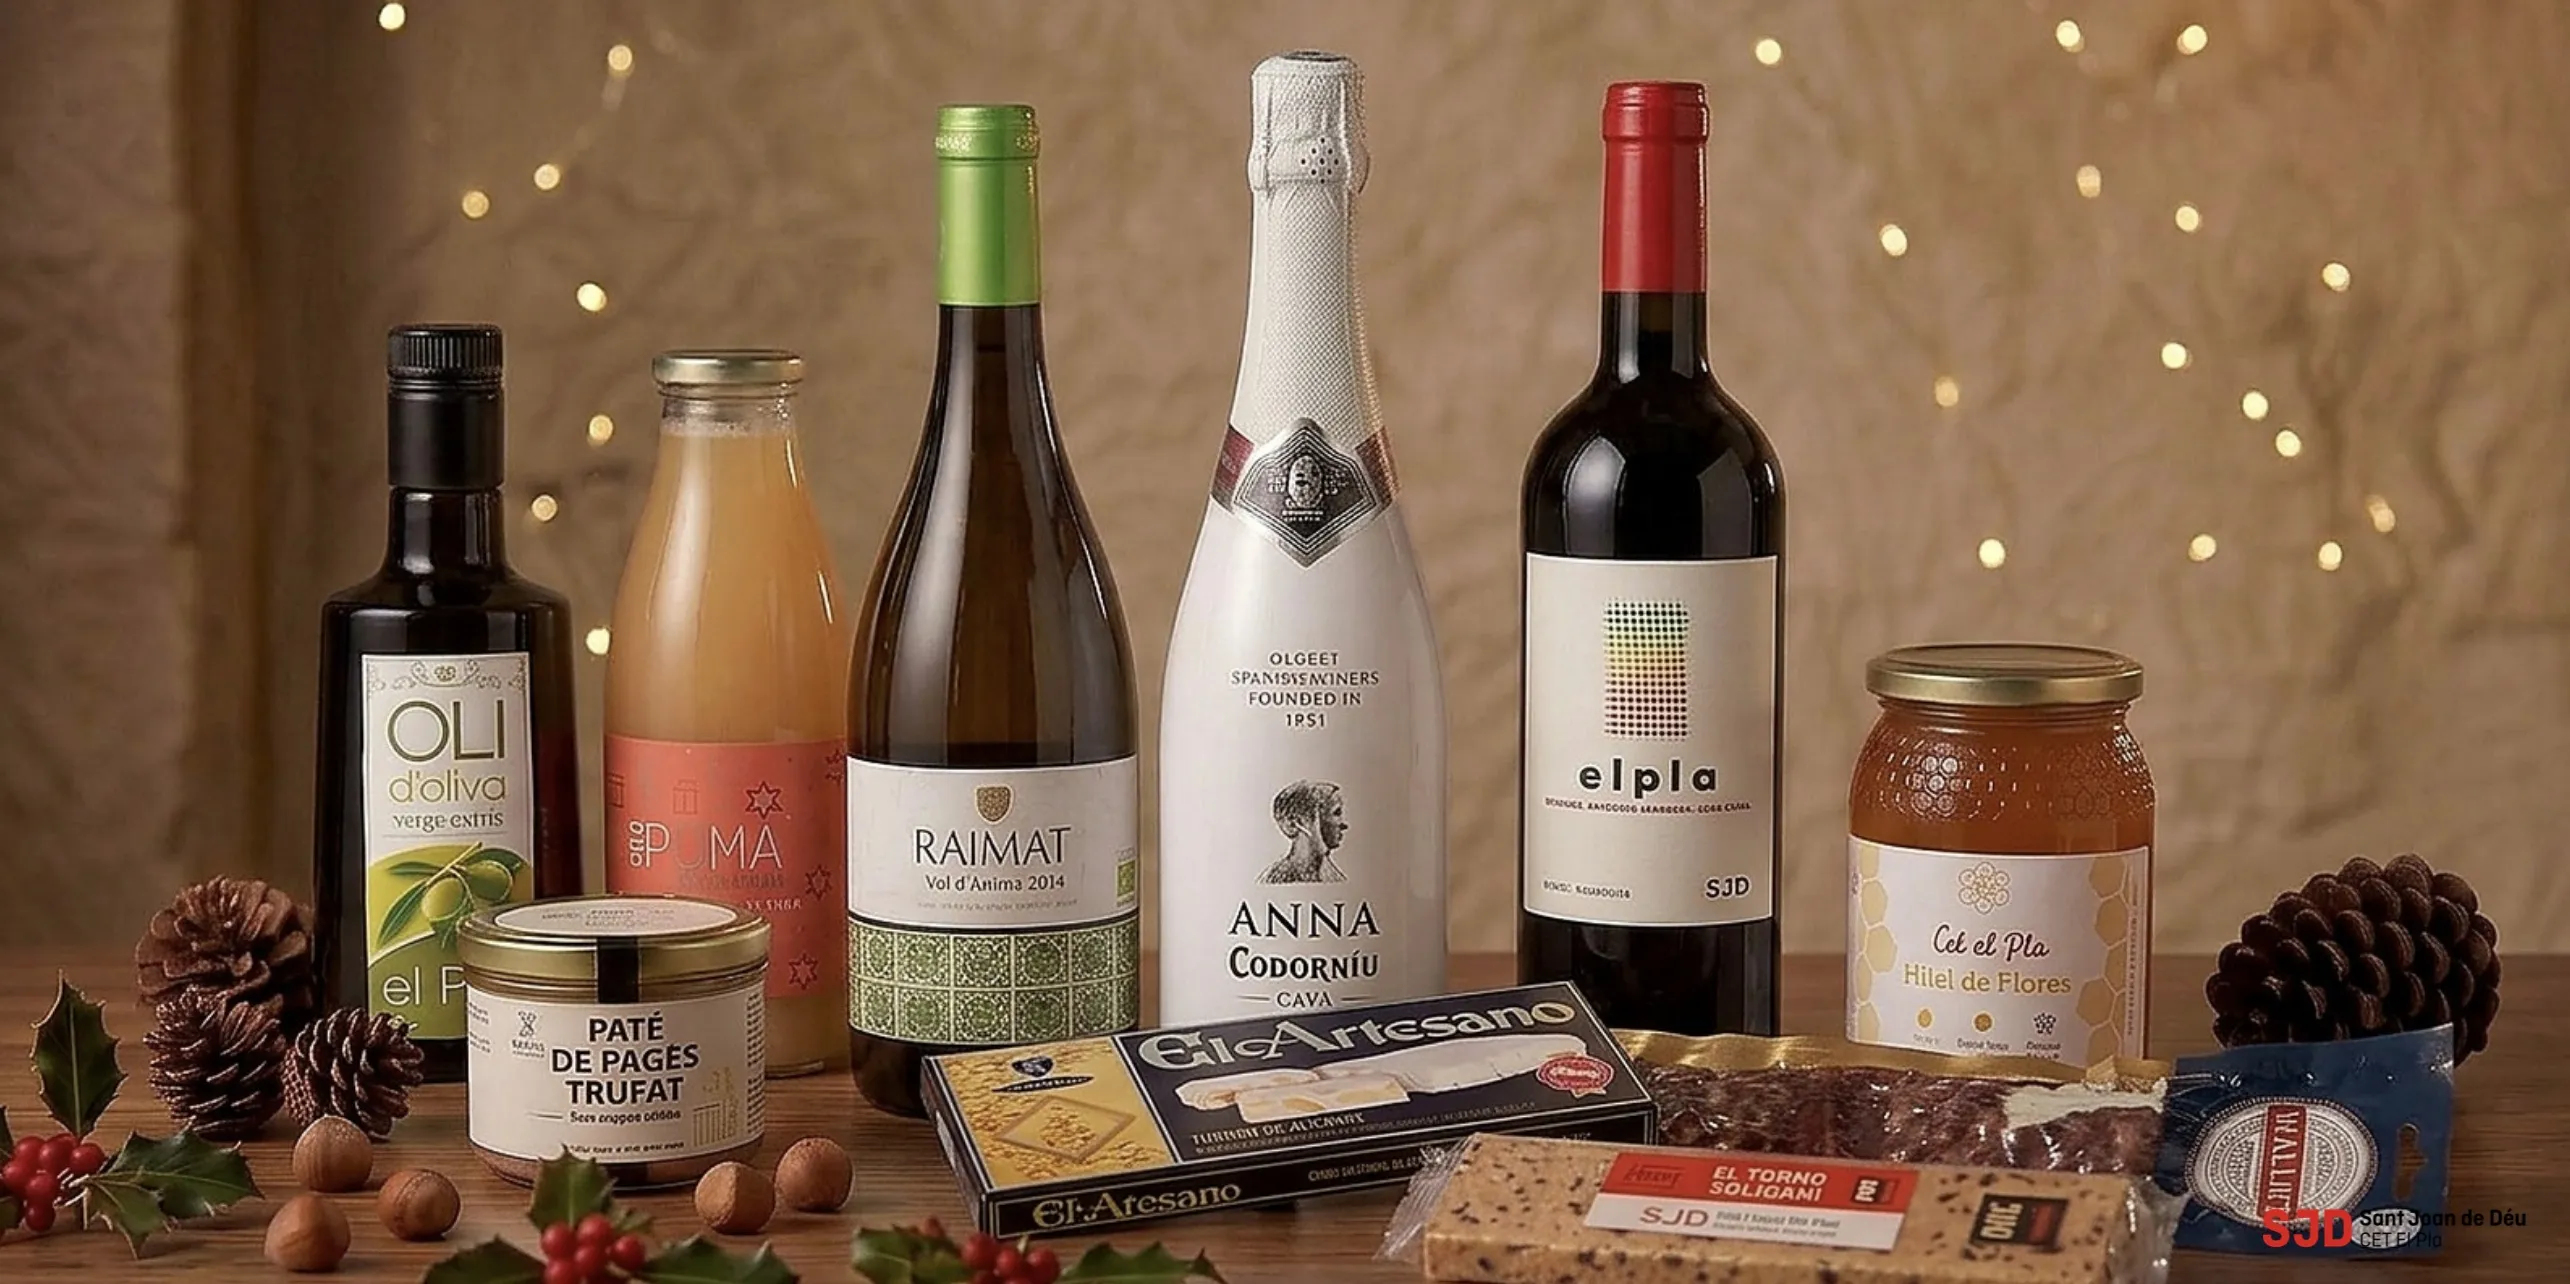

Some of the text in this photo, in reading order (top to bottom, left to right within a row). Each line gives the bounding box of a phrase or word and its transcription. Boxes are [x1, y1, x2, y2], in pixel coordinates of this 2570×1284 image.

[1269, 652, 1339, 666] OLGEET
[1249, 691, 1362, 706] FOUNDED IN
[387, 700, 505, 762] OLI
[389, 768, 506, 803] d'oliva
[1579, 757, 1717, 800] elpla
[915, 827, 1071, 865] RAIMAT
[925, 875, 950, 891] Vol
[1028, 875, 1065, 890] 2014
[1706, 876, 1750, 899] SJD
[1228, 901, 1381, 938] ANNA
[1973, 932, 1997, 957] el
[2003, 932, 2051, 962] Pla
[383, 966, 420, 1006] el
[1903, 963, 2072, 994] Hilel de Flores
[1276, 991, 1334, 1008] CAVA
[588, 1010, 664, 1042] PATÉ
[1138, 1001, 1576, 1070] El Artesano
[551, 1048, 592, 1073] DE
[564, 1077, 685, 1106] TRUFAT
[1712, 1166, 1828, 1187] EL TORNO
[1639, 1206, 1709, 1227] SJD
